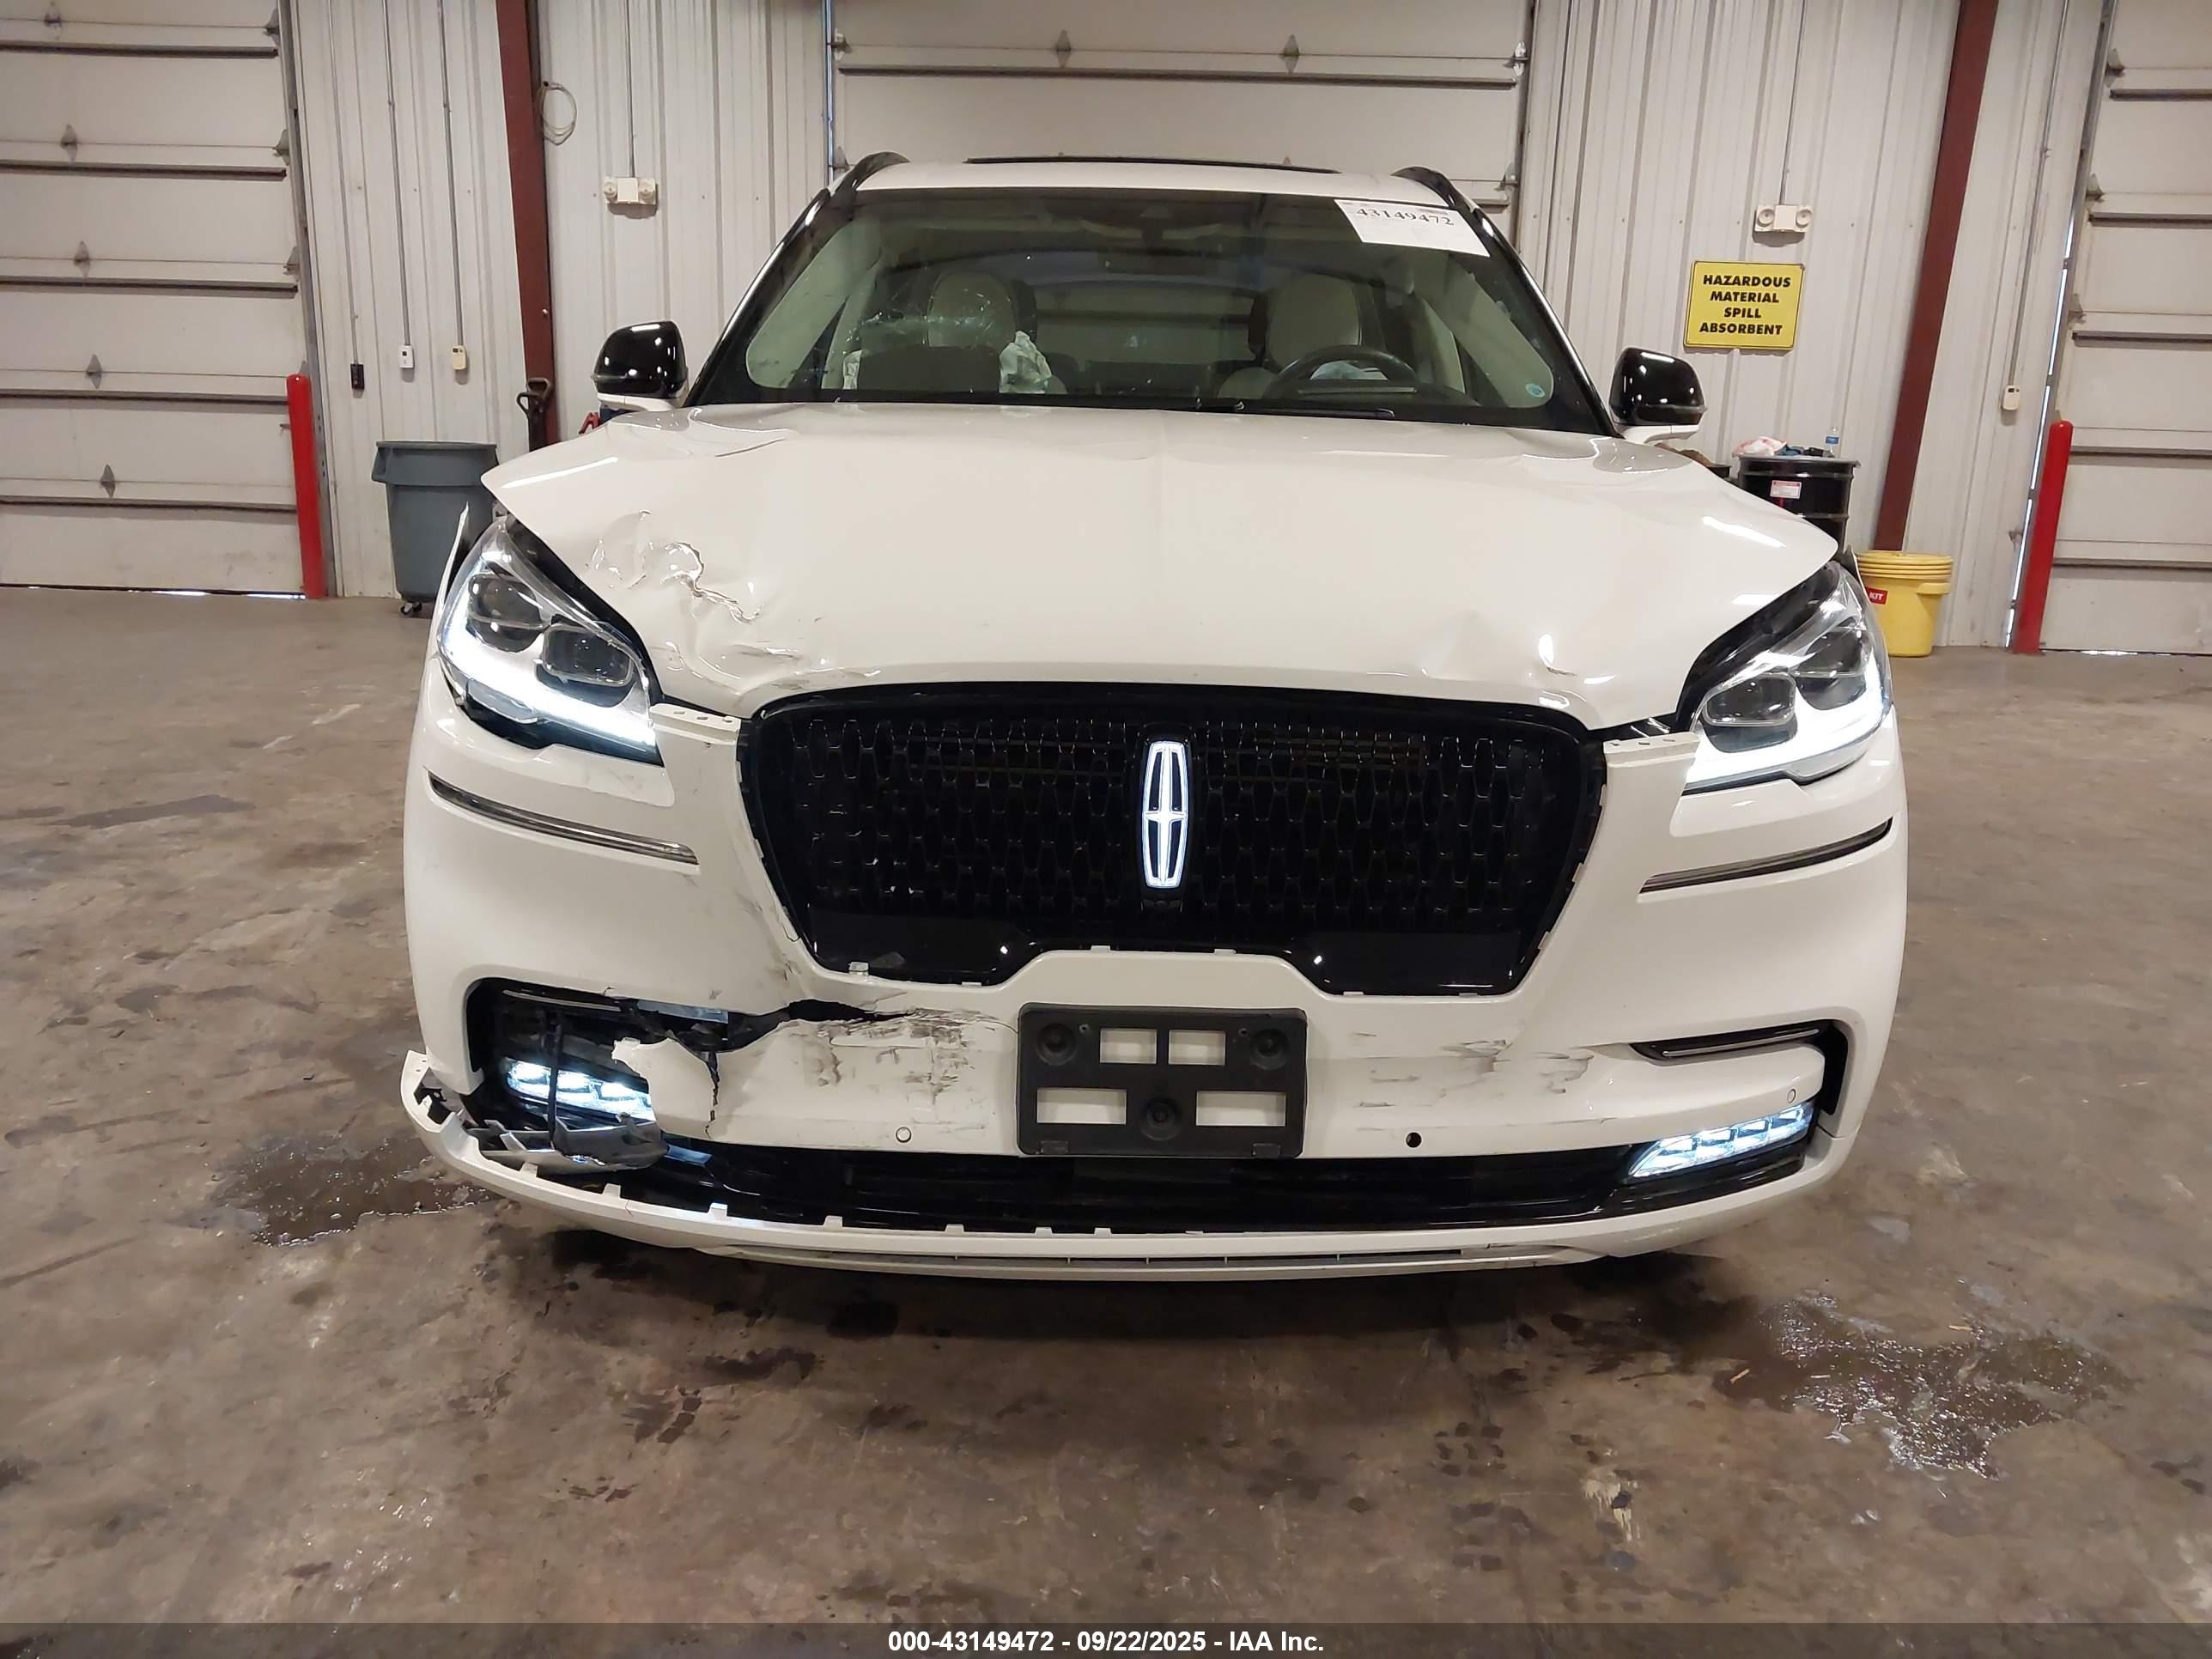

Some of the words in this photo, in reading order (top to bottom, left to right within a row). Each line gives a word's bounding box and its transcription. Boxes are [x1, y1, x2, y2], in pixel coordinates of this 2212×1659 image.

[1356, 207, 1455, 227] 43149472
[1703, 274, 1791, 288] HAZARDOUS
[1710, 291, 1780, 303] MATERIAL
[1723, 307, 1762, 319] SPILL
[1698, 322, 1783, 335] ABSORBENT
